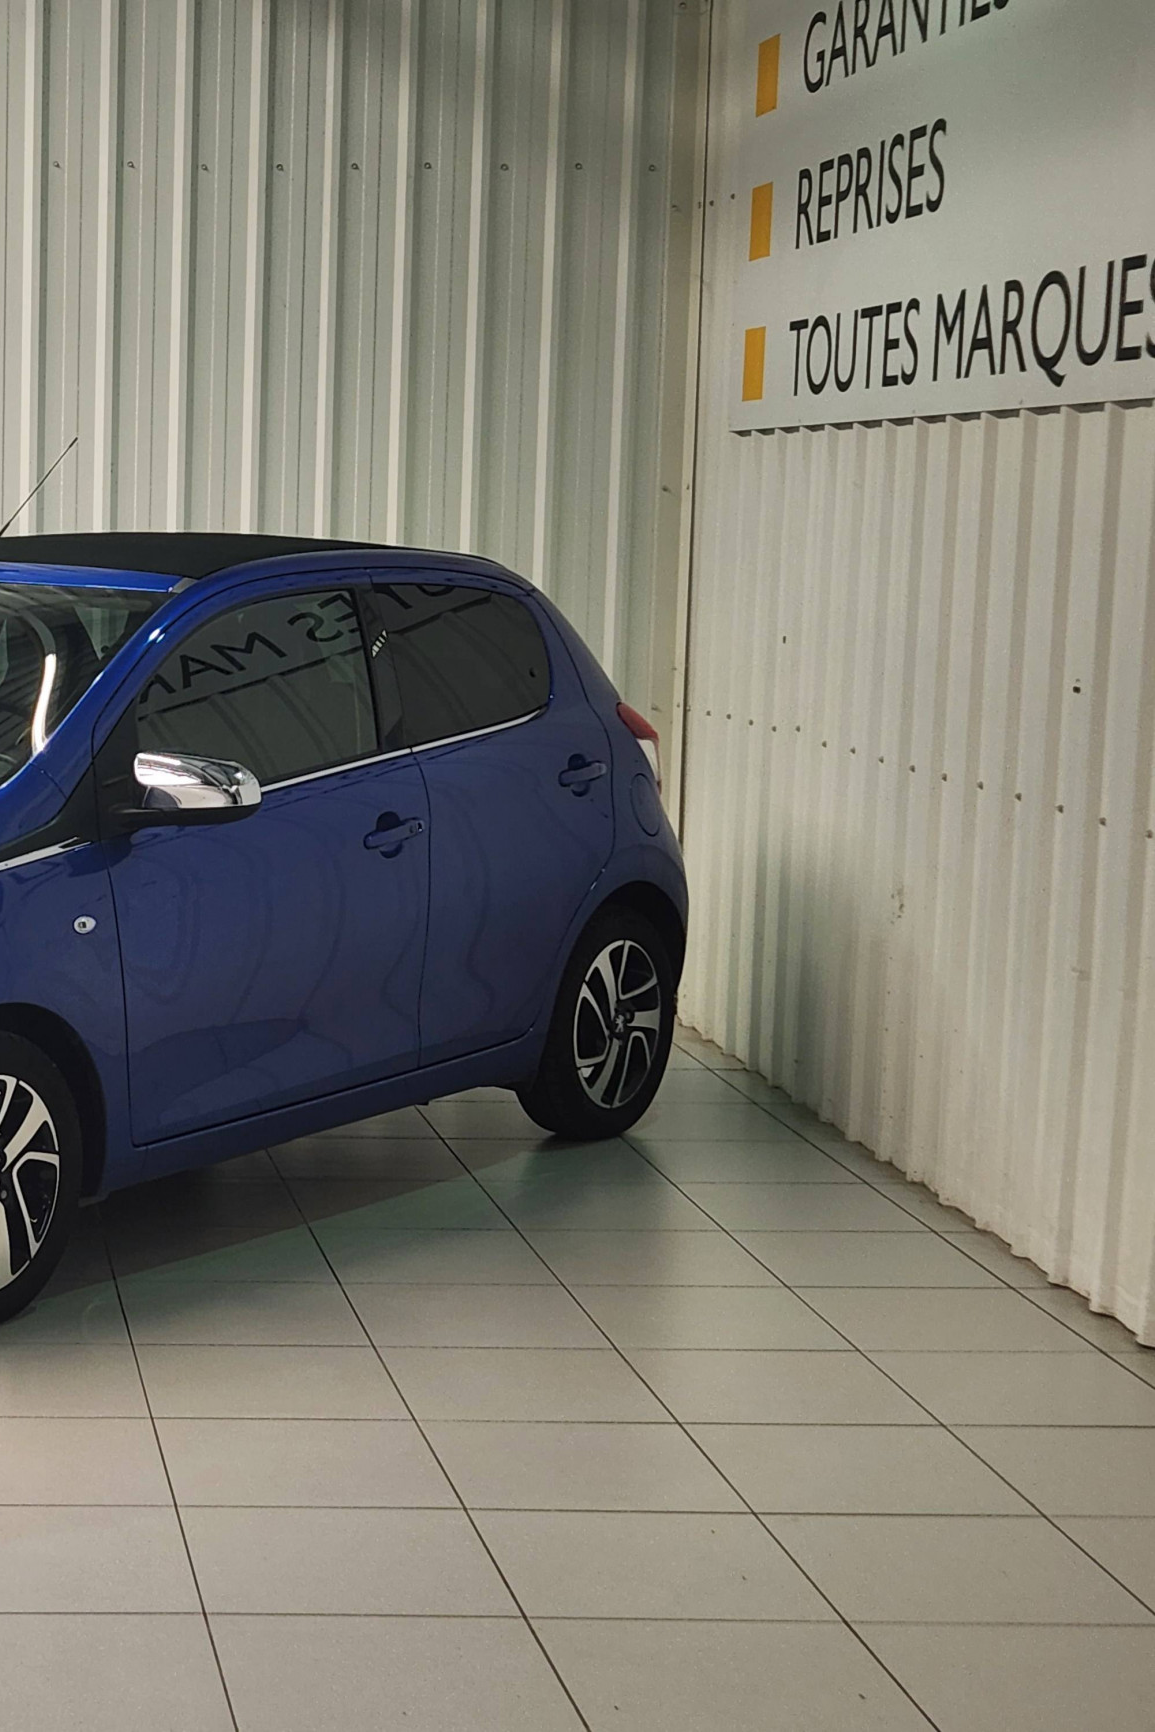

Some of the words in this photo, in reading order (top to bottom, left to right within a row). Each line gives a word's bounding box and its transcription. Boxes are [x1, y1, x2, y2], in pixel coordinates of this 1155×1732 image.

[803, 0, 1009, 93] GARAN
[795, 118, 947, 249] REPRISES
[789, 298, 920, 397] TOUTES
[932, 253, 1155, 387] MARQUE
